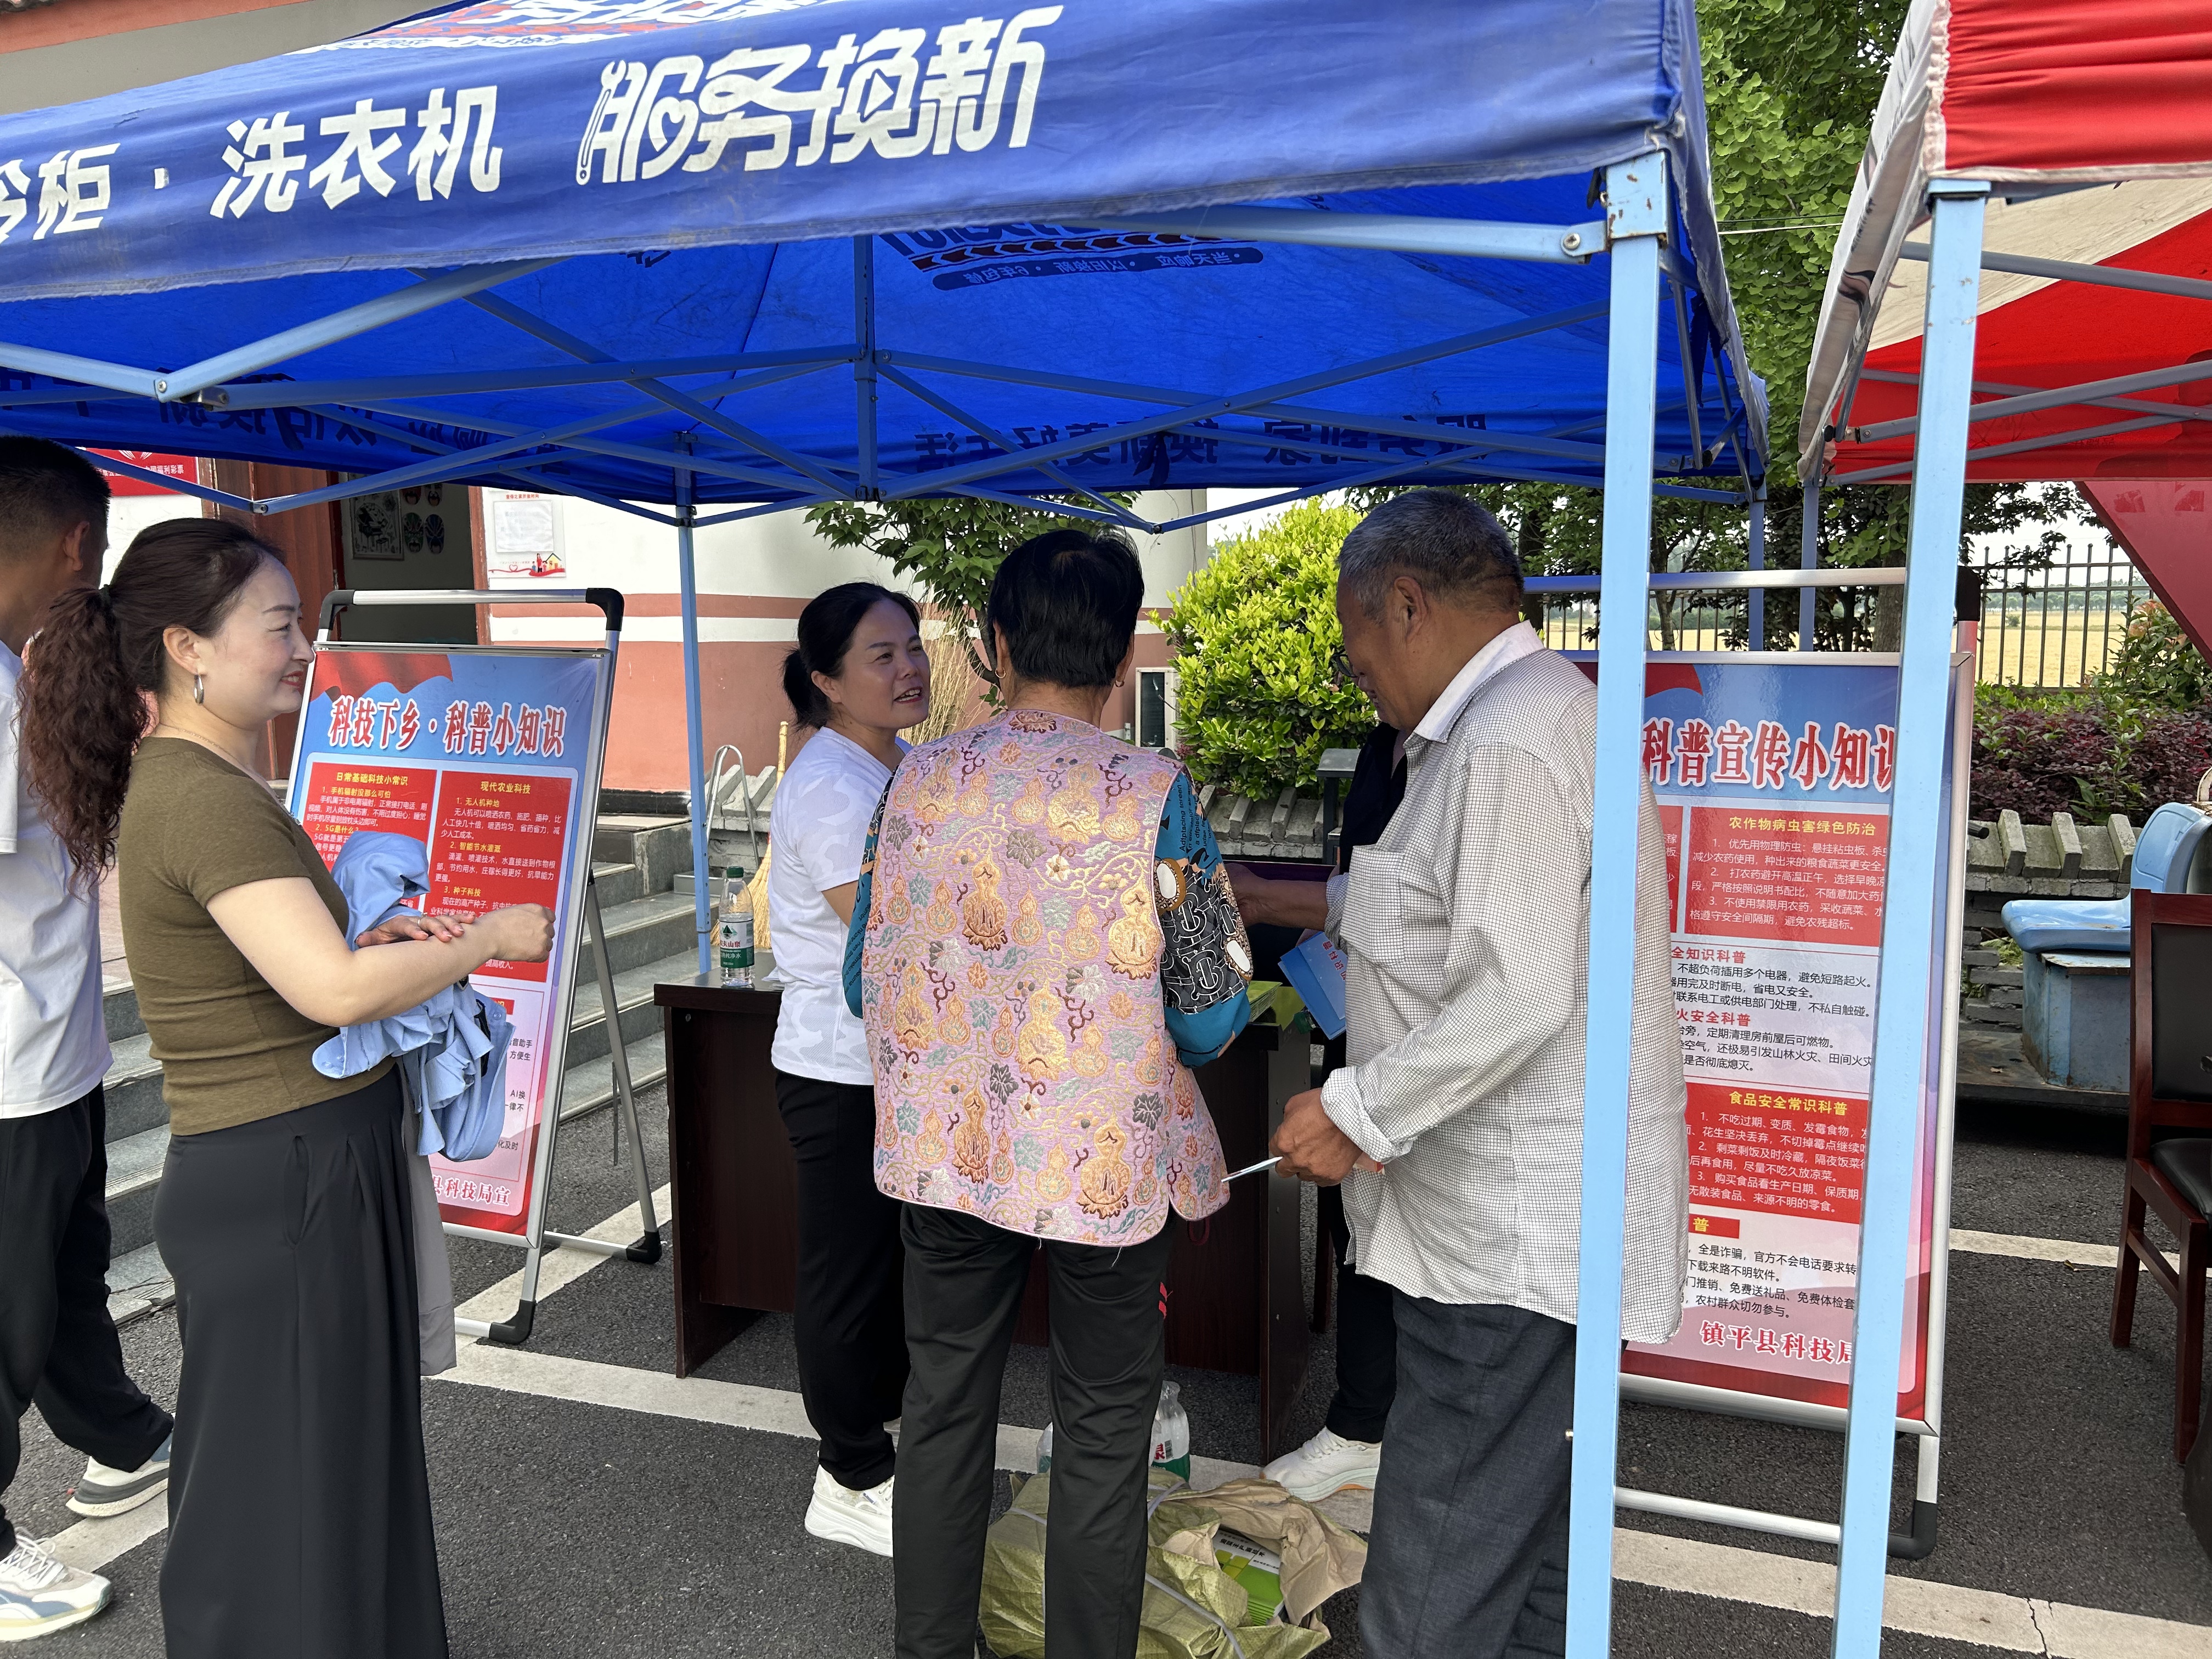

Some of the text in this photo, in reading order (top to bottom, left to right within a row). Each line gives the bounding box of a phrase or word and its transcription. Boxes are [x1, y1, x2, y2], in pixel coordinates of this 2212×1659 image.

[575, 4, 1064, 185] 服务换新
[329, 695, 567, 758] 科技下乡·科普小知识
[336, 772, 409, 786] 日常基础科技小常识
[480, 781, 531, 794] 现代农业科技
[1728, 816, 1876, 837] 农作物病虫害绿色防治
[1692, 851, 1886, 872] 减少农药使用，种出来的粮食蔬菜更安全。
[1690, 909, 1854, 930] 格遵守安全间隔期，避免农残超标。
[1671, 946, 1746, 964] 全知识科普
[1677, 962, 1871, 988] 不超负荷插用多个电器，避免短路起火。
[1672, 990, 1870, 1017] 联系电工或供电部门处理，不私自触碰。
[1676, 1008, 1751, 1027] 火安全科普
[510, 1051, 531, 1061] 方便生
[1680, 1053, 1753, 1071] 是否彻底熄灭。
[1729, 1090, 1848, 1116] 食品安全常识科普
[1693, 1217, 1710, 1233] 普
[1688, 1258, 1779, 1282] 下载来路不明软件。
